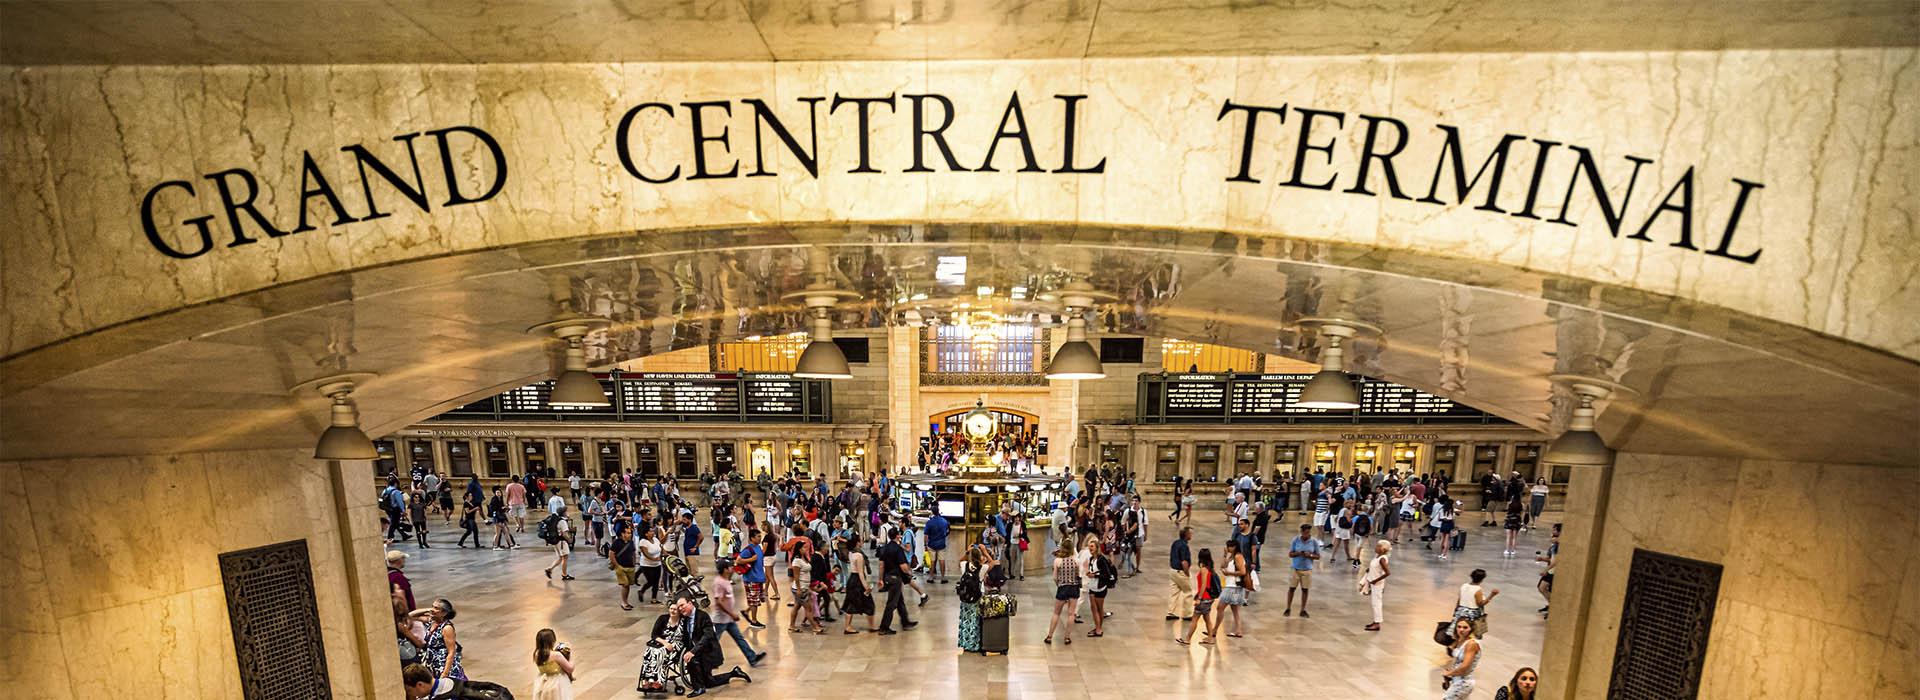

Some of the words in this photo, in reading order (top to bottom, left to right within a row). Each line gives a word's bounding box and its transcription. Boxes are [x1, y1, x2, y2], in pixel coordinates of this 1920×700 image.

[139, 125, 508, 260] GRAND
[615, 90, 1107, 185] CENTRAL
[1217, 98, 1766, 265] TERMINAL
